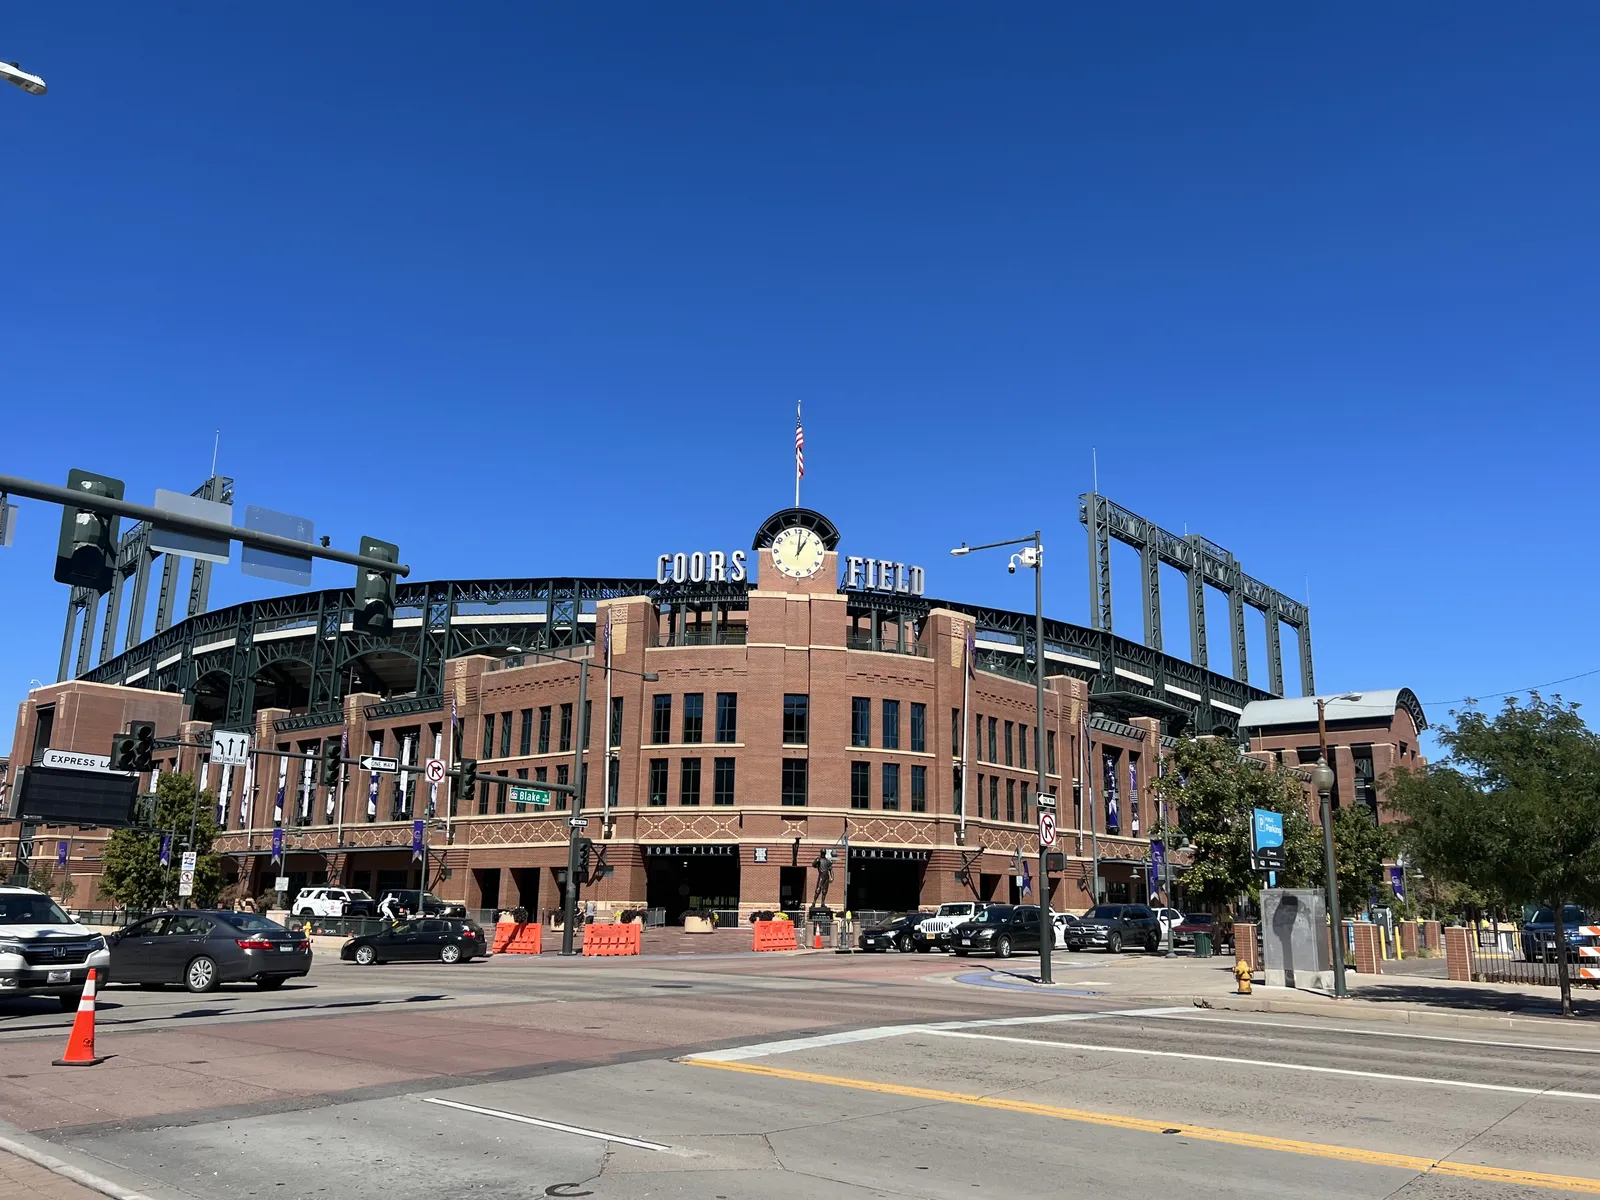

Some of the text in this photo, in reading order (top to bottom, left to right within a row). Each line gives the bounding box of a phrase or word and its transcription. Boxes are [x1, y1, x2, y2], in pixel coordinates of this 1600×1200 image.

[656, 550, 748, 585] COORS
[845, 556, 925, 596] FIELD
[50, 755, 95, 767] EXPRESS
[519, 791, 540, 802] Blake
[1265, 823, 1282, 837] Parking
[646, 846, 731, 855] HOME PLATE
[852, 849, 928, 860] HOME PLATE
